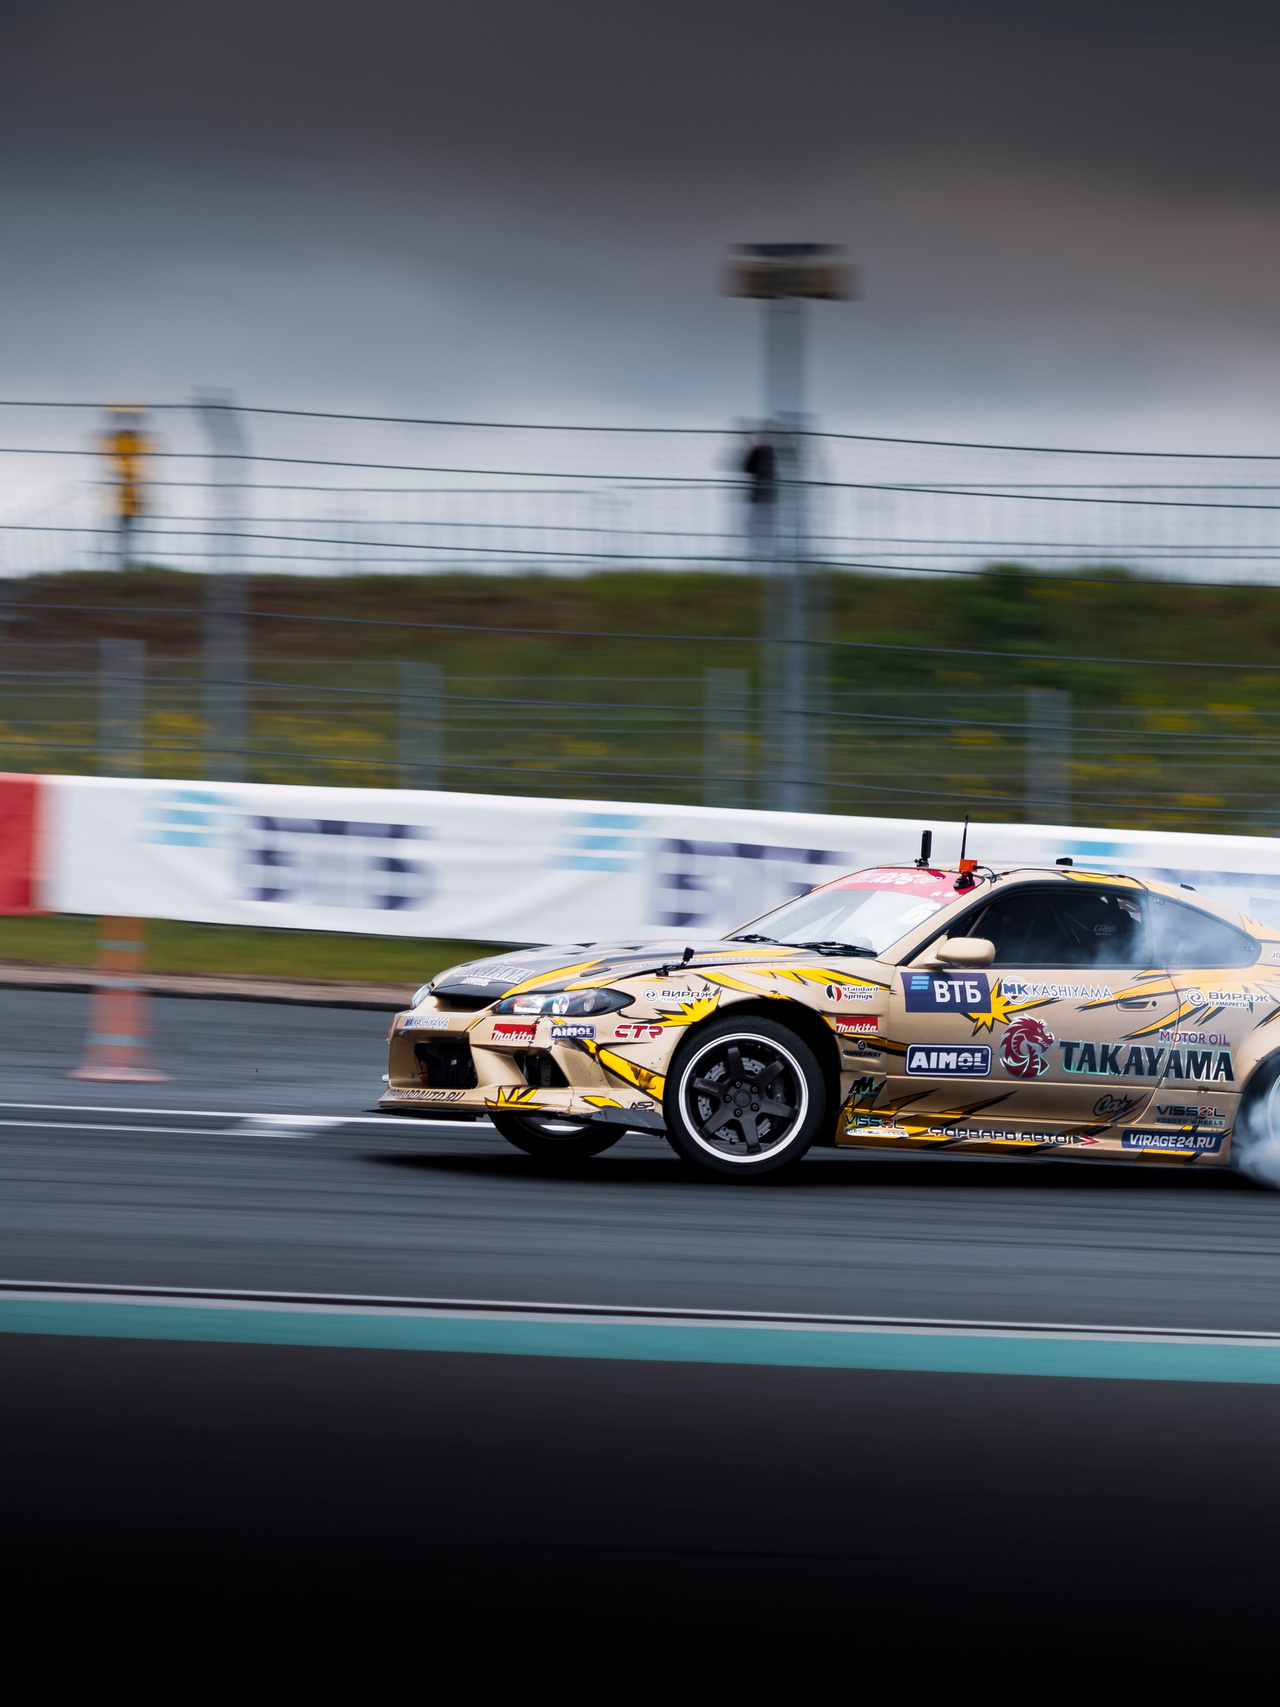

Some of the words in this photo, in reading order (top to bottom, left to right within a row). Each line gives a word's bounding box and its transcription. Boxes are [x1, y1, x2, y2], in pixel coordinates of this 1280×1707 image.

[661, 990, 714, 998] ВИРАЖ
[933, 980, 982, 1004] ВТБ
[1003, 983, 1029, 996] MK
[1031, 984, 1113, 1000] KASHIYAMA
[1209, 992, 1269, 1002] ВИРАЖ
[552, 1027, 593, 1038] AIMOL
[614, 1025, 664, 1038] CTR
[1160, 1030, 1206, 1045] MOTOR
[1208, 1034, 1230, 1046] OIL
[910, 1051, 987, 1070] AIMOL
[1059, 1040, 1236, 1083] TAKAYAMA
[1155, 1104, 1227, 1118] VISSOL
[845, 1115, 906, 1130] VISSOL
[1129, 1133, 1217, 1149] VIRAGE24.RU
